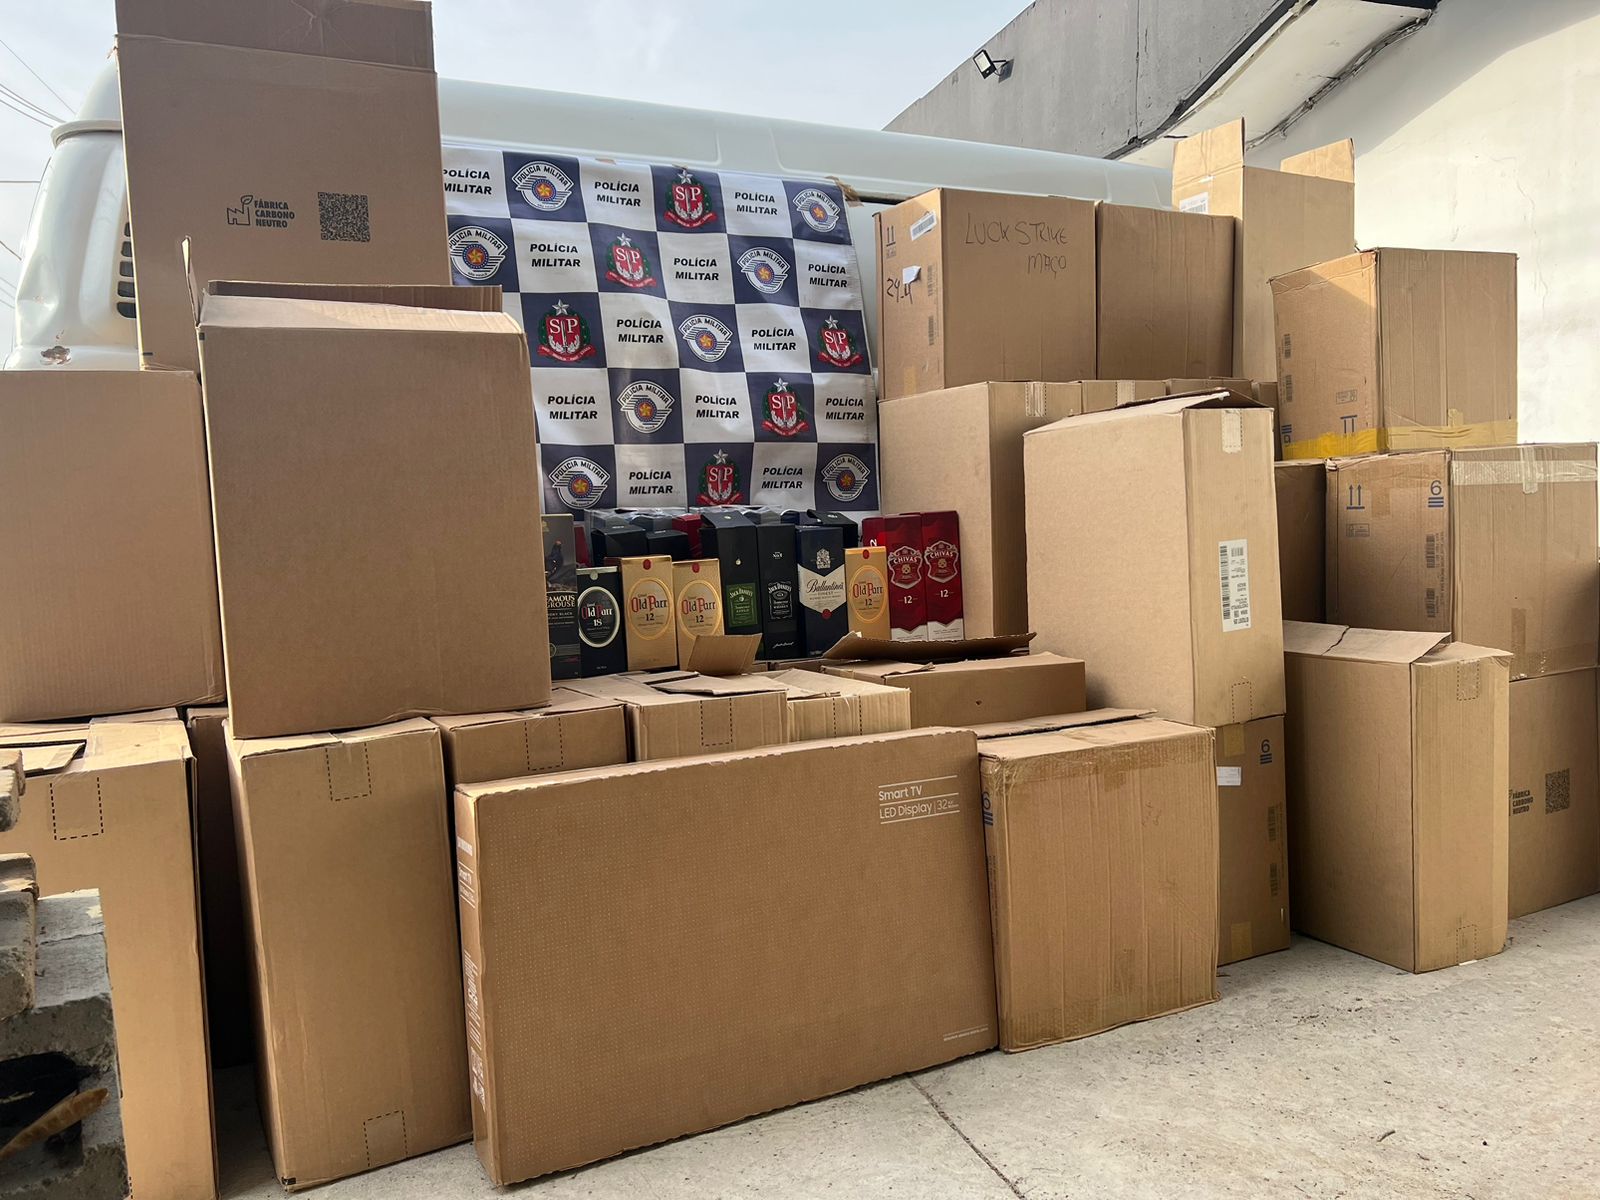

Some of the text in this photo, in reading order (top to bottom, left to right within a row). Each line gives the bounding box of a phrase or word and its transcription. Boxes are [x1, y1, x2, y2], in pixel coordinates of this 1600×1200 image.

[444, 183, 492, 195] MILITAR
[594, 181, 639, 192] POLÍCIA
[596, 194, 641, 207] MILITAR
[734, 191, 775, 203] POLÍCIA
[254, 198, 289, 210] FÁBRICA
[255, 209, 295, 219] CARBONO
[736, 204, 778, 215] MILITAR
[256, 219, 288, 228] NEUTRO
[965, 212, 1010, 244] LUCK
[530, 243, 578, 253] POLÍCIA
[531, 258, 581, 267] MILITAR
[674, 257, 718, 267] POLÍCIA
[808, 263, 846, 274] POLÍCIA
[675, 271, 719, 281] MILITAR
[809, 277, 848, 288] MILITAR
[616, 317, 662, 329] POLÍCIA
[751, 327, 795, 337] POLÍCIA
[618, 333, 664, 343] MILITAR
[753, 342, 796, 351] MILITAR
[547, 393, 596, 405] POLÍCIA
[695, 394, 737, 406] POLÍCIA
[825, 396, 864, 407] POLÍCIA
[549, 411, 598, 420] MILITAR
[696, 409, 739, 419] MILITAR
[825, 411, 865, 420] MILITAR
[629, 469, 672, 480] POLÍCIA
[762, 466, 803, 476] POLÍCIA
[761, 480, 803, 489] MILITAR
[1430, 479, 1442, 496] 6
[629, 485, 673, 495] MILITAR
[893, 556, 917, 564] CHIVAS
[929, 551, 953, 559] CHIVAS
[852, 582, 883, 598] Old Parr
[940, 590, 949, 598] 12
[547, 594, 575, 602] AMOUS
[903, 595, 913, 604] 12
[631, 595, 668, 613] Old Parr
[682, 597, 716, 615] Old Parr
[582, 604, 613, 619] Old Parr
[646, 613, 655, 621] 12
[695, 614, 704, 623] 12
[593, 619, 603, 627] 18
[1261, 739, 1270, 753] 6
[878, 785, 923, 801] Smart TV
[880, 806, 897, 819] LED
[898, 802, 932, 817] Display
[937, 799, 948, 810] 32
